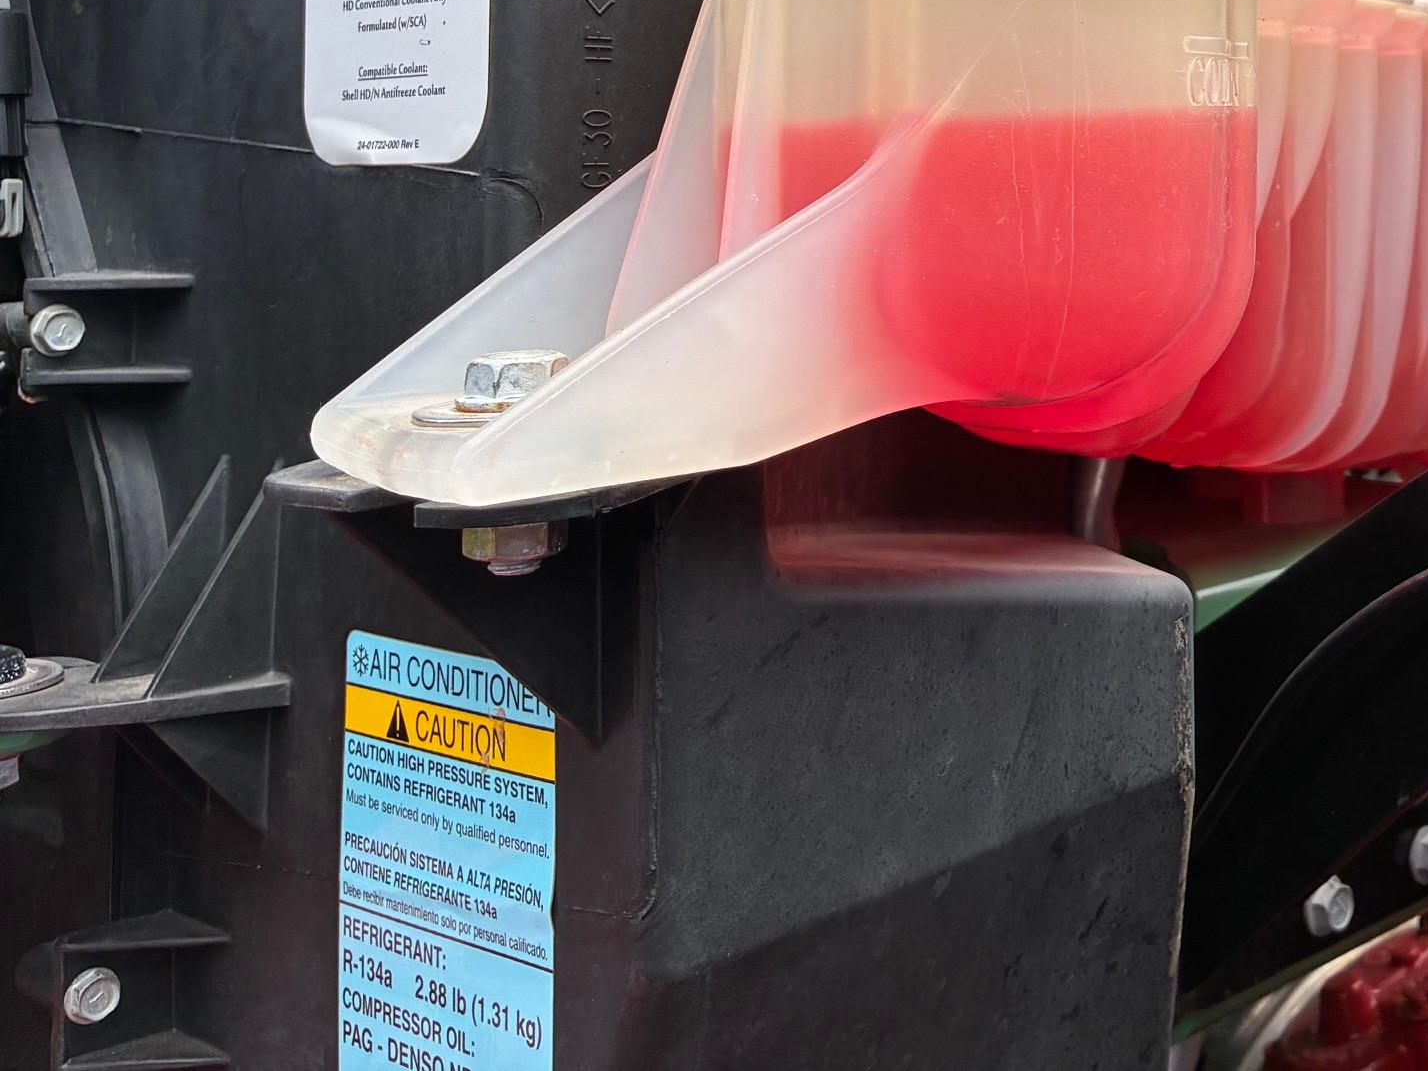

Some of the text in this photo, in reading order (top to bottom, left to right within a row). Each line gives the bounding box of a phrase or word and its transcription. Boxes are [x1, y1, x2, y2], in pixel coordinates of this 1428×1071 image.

[343, 0, 354, 12] HD
[358, 14, 427, 32] Formulated (w/SCA)
[342, 84, 446, 101] Shell HD/N Antifreeze Coolant
[358, 61, 428, 78] Compatible Coolant:
[401, 139, 413, 149] Rev
[415, 139, 420, 148] E
[370, 648, 401, 684] AIR
[415, 710, 506, 762] CAUTION
[347, 763, 516, 824] CONTAINS REFRIGERANT 134a
[348, 739, 548, 809] CAUTION HIGH PRESSURE SYSTEM,
[346, 788, 550, 859] Must be serviced only by qualified personnel.
[344, 855, 498, 920] CONTIENE REFRIGERANTE 134a
[345, 831, 544, 911] PRECAUCIÓN SISTEMA A ALTA PRESIÓN,
[343, 881, 548, 961] Debe recibir mantenimiento solo por personal calificado.
[343, 915, 447, 970] REFRIGERANT:
[342, 987, 475, 1057] COMPRESSOR OIL:
[343, 949, 542, 1050] R-134a 2.88 lb (1.31 kg)
[343, 1020, 373, 1053] PAG
[388, 1037, 445, 1071] DENSO
